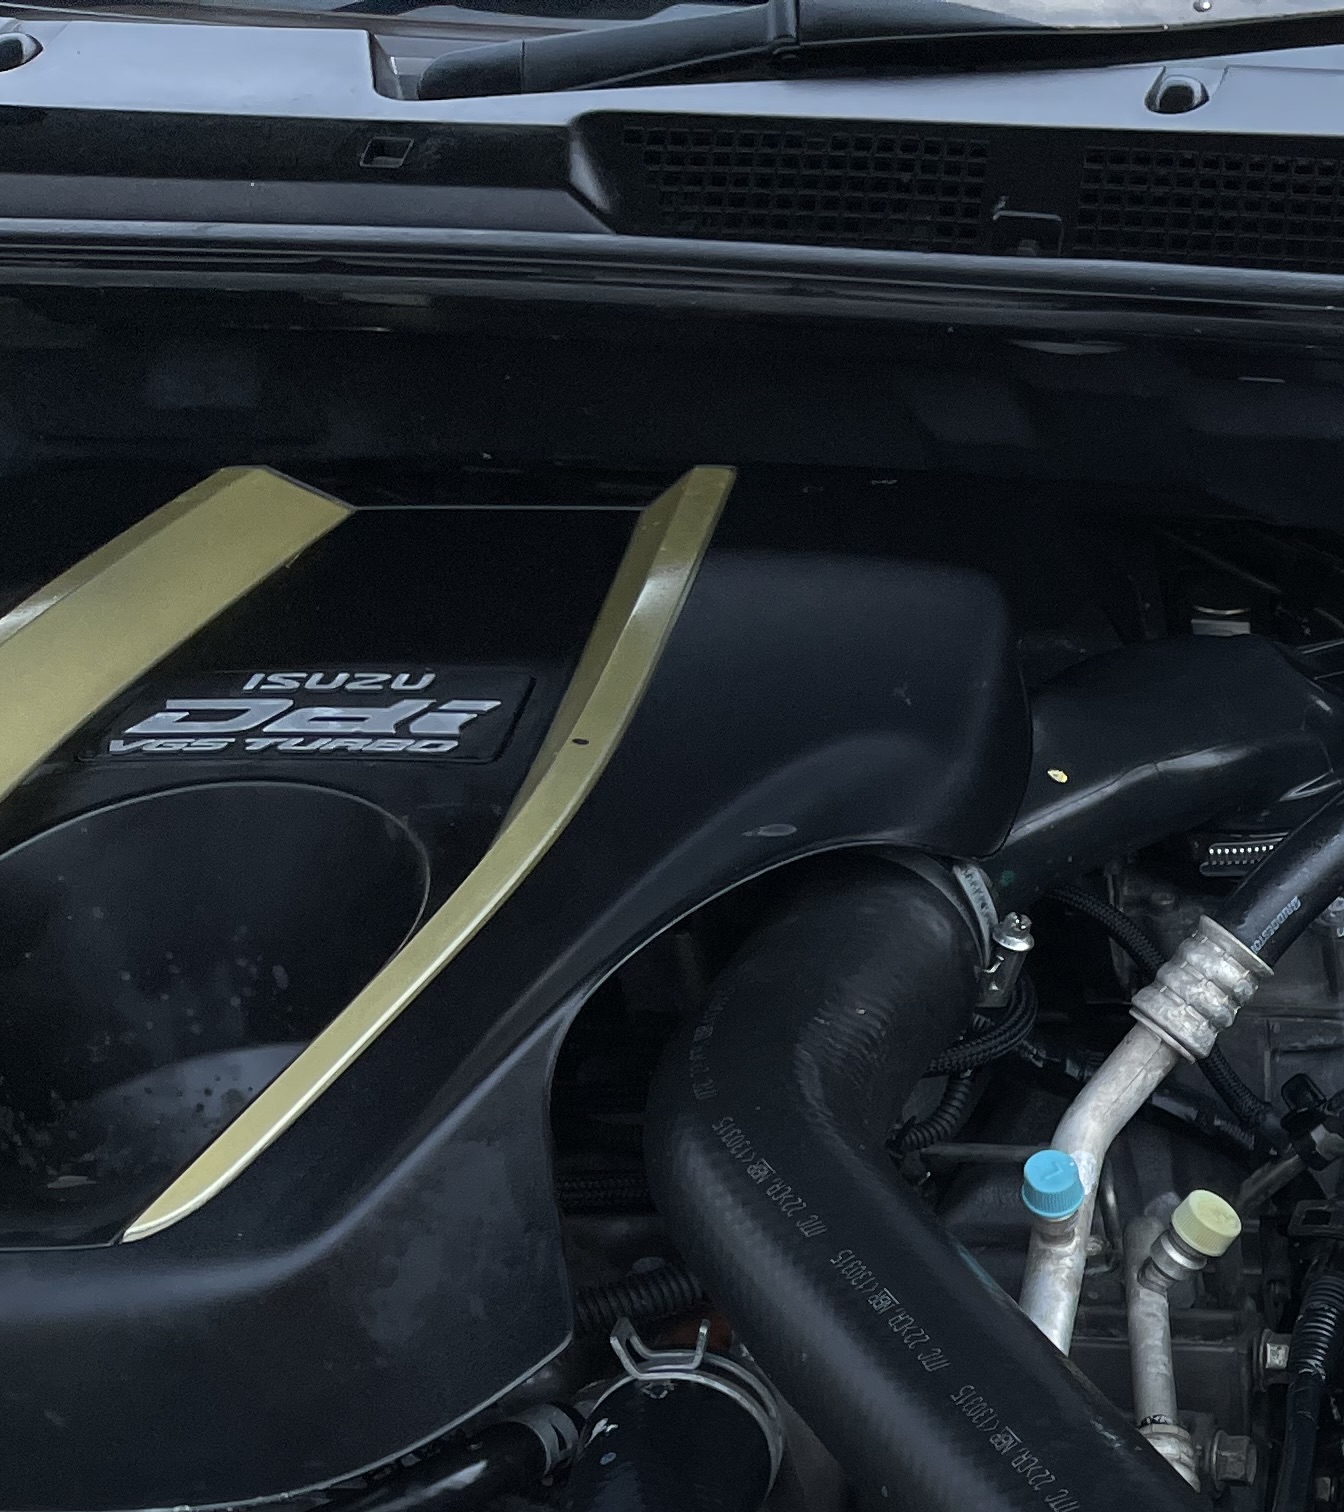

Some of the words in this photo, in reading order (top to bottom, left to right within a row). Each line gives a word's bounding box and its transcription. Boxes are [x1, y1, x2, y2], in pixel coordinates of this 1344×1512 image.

[242, 673, 436, 692] ISUZU
[108, 738, 235, 754] VGS
[243, 738, 459, 754] TURBO
